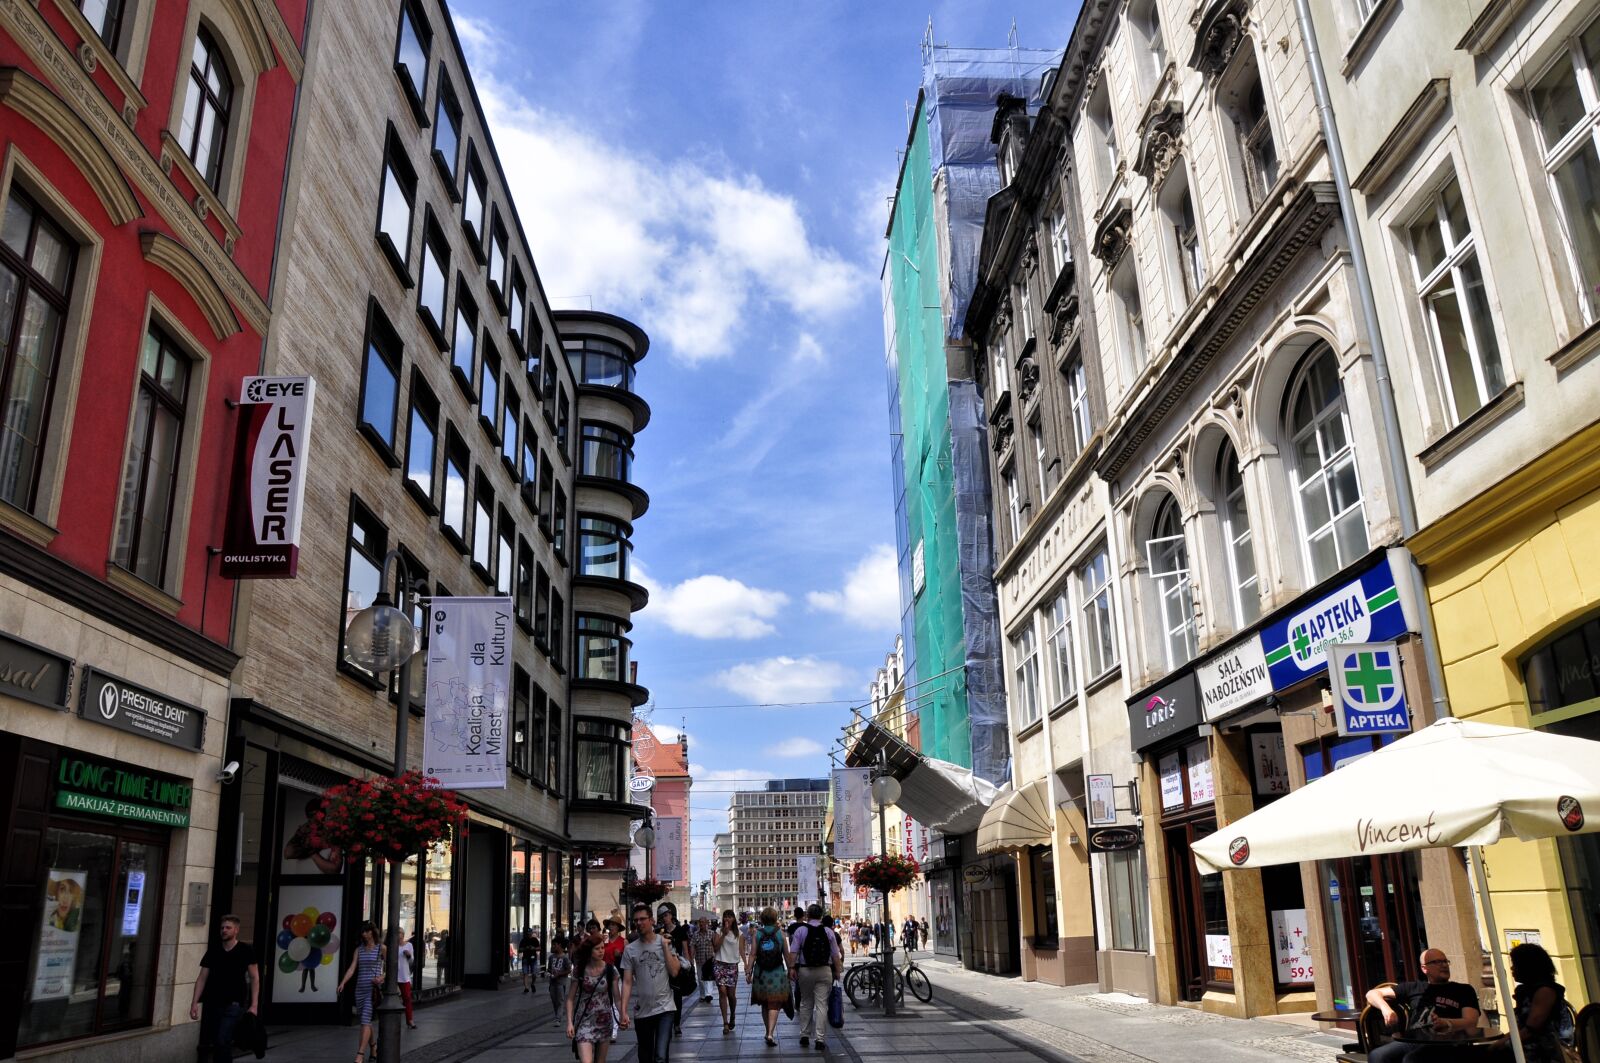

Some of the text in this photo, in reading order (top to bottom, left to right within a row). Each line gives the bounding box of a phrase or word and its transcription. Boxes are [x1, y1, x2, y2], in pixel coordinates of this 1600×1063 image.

[265, 383, 304, 397] EYE
[260, 406, 297, 541] LASER
[224, 555, 287, 563] OKULISTYKA
[1309, 594, 1365, 643] APTEKA
[486, 611, 509, 755] Miast Kultury
[1205, 663, 1266, 706] NABOŻEŃSTW
[1218, 655, 1242, 679] SALA
[121, 688, 185, 724] PRESTIGE DENT
[466, 642, 487, 756] Koalicja dla
[1349, 714, 1405, 729] APTEKA
[59, 757, 192, 809] LONG-TIME-LINER
[631, 780, 649, 788] GANT
[66, 794, 187, 825] MAKIJAŻ PERMANENTNY
[905, 814, 914, 861] APTEKA
[1357, 811, 1442, 852] Vincent
